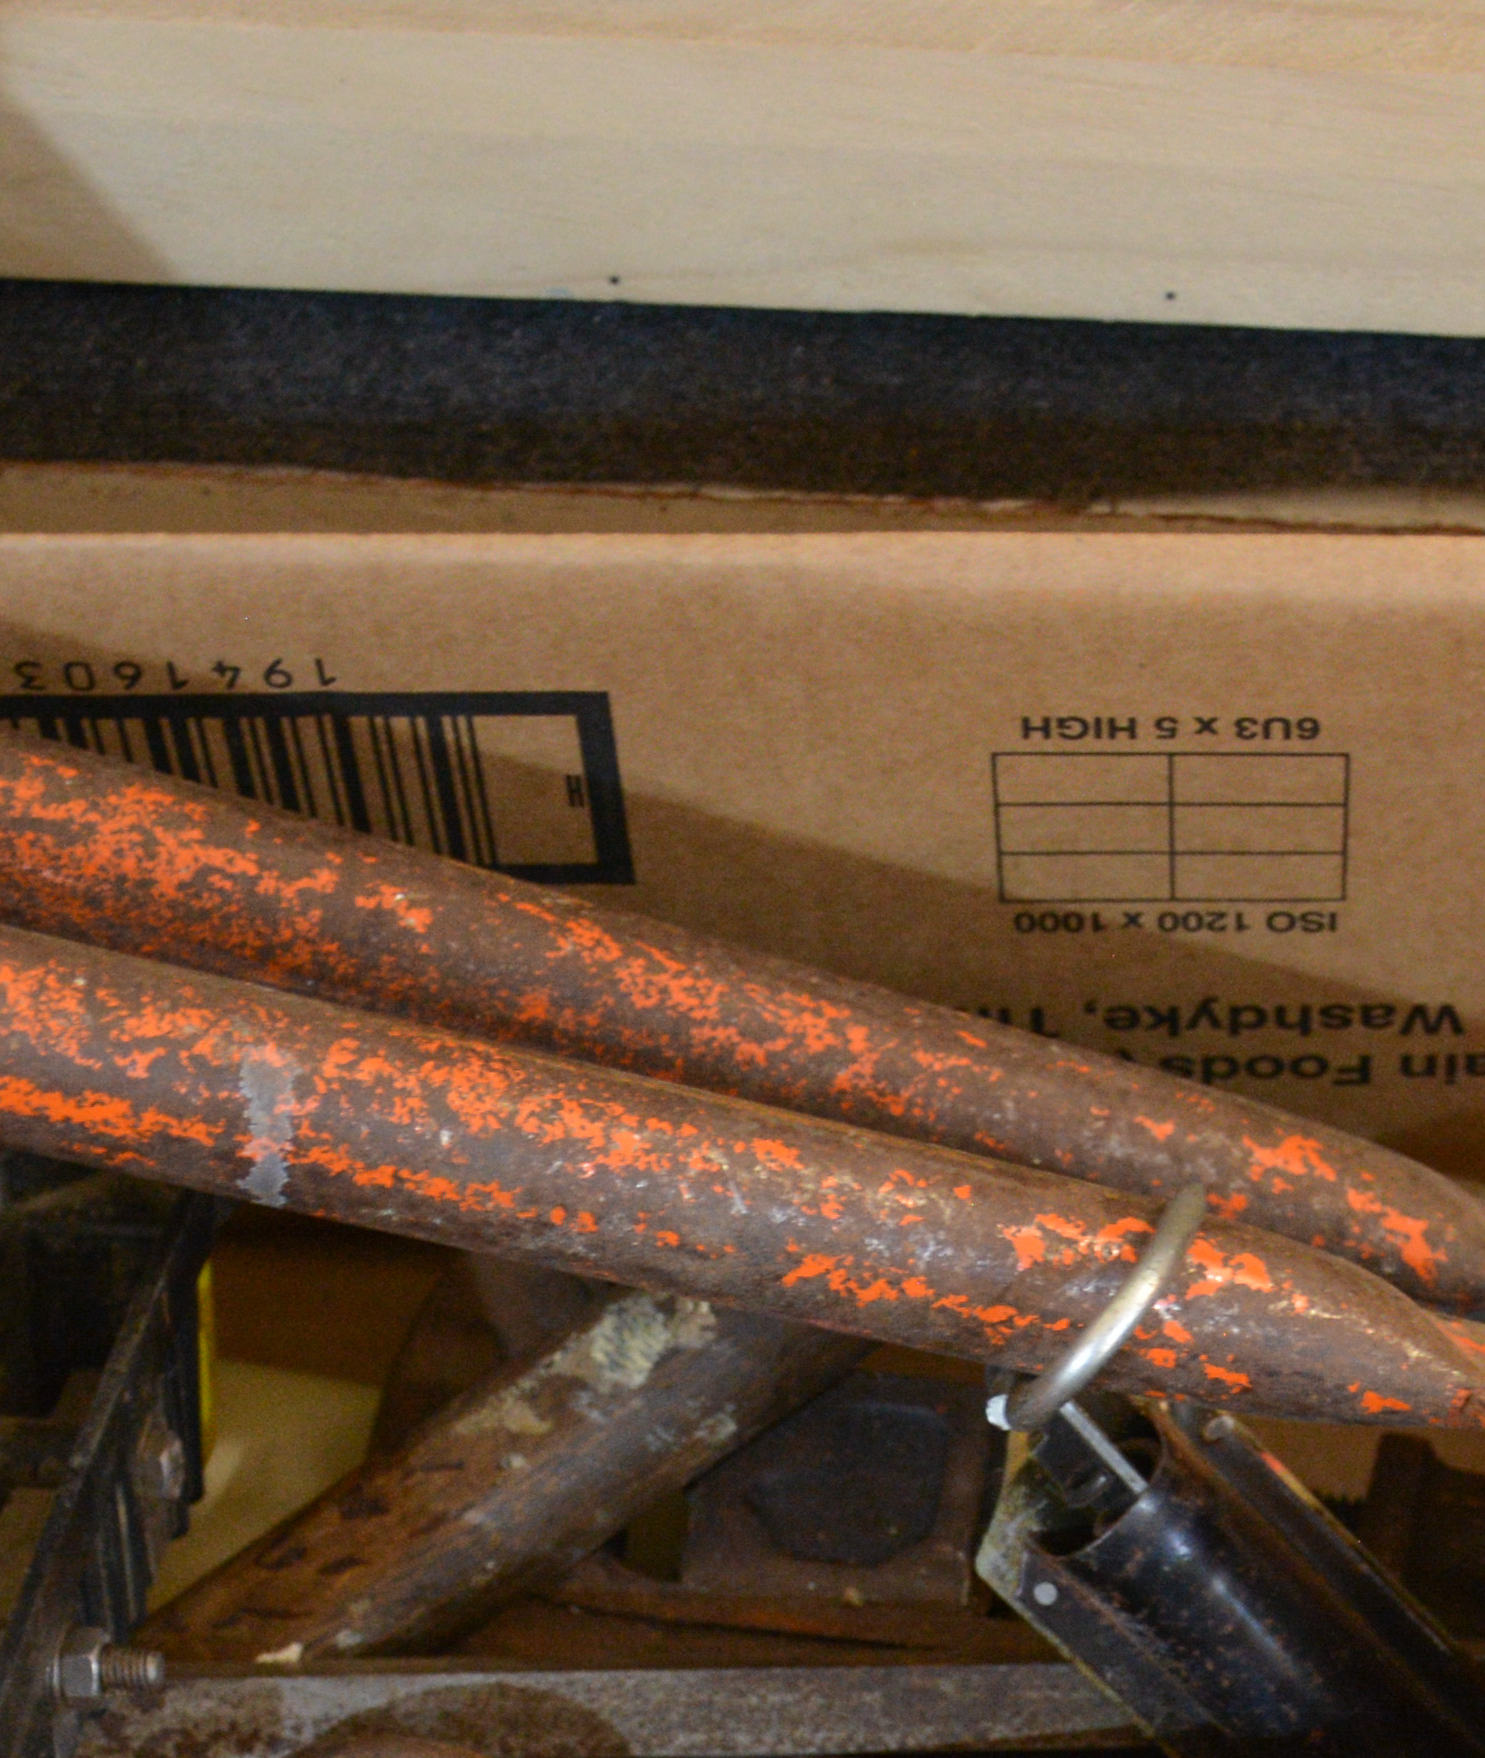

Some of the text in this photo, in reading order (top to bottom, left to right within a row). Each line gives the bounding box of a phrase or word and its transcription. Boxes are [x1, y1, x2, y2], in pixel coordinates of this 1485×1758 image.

[1020, 715, 1138, 739] HIGH
[1156, 717, 1179, 739] 5
[1013, 911, 1107, 934] 1000
[1158, 911, 1251, 934] 1200
[1268, 910, 1338, 933] ISO
[1082, 996, 1464, 1038] Washdyke,
